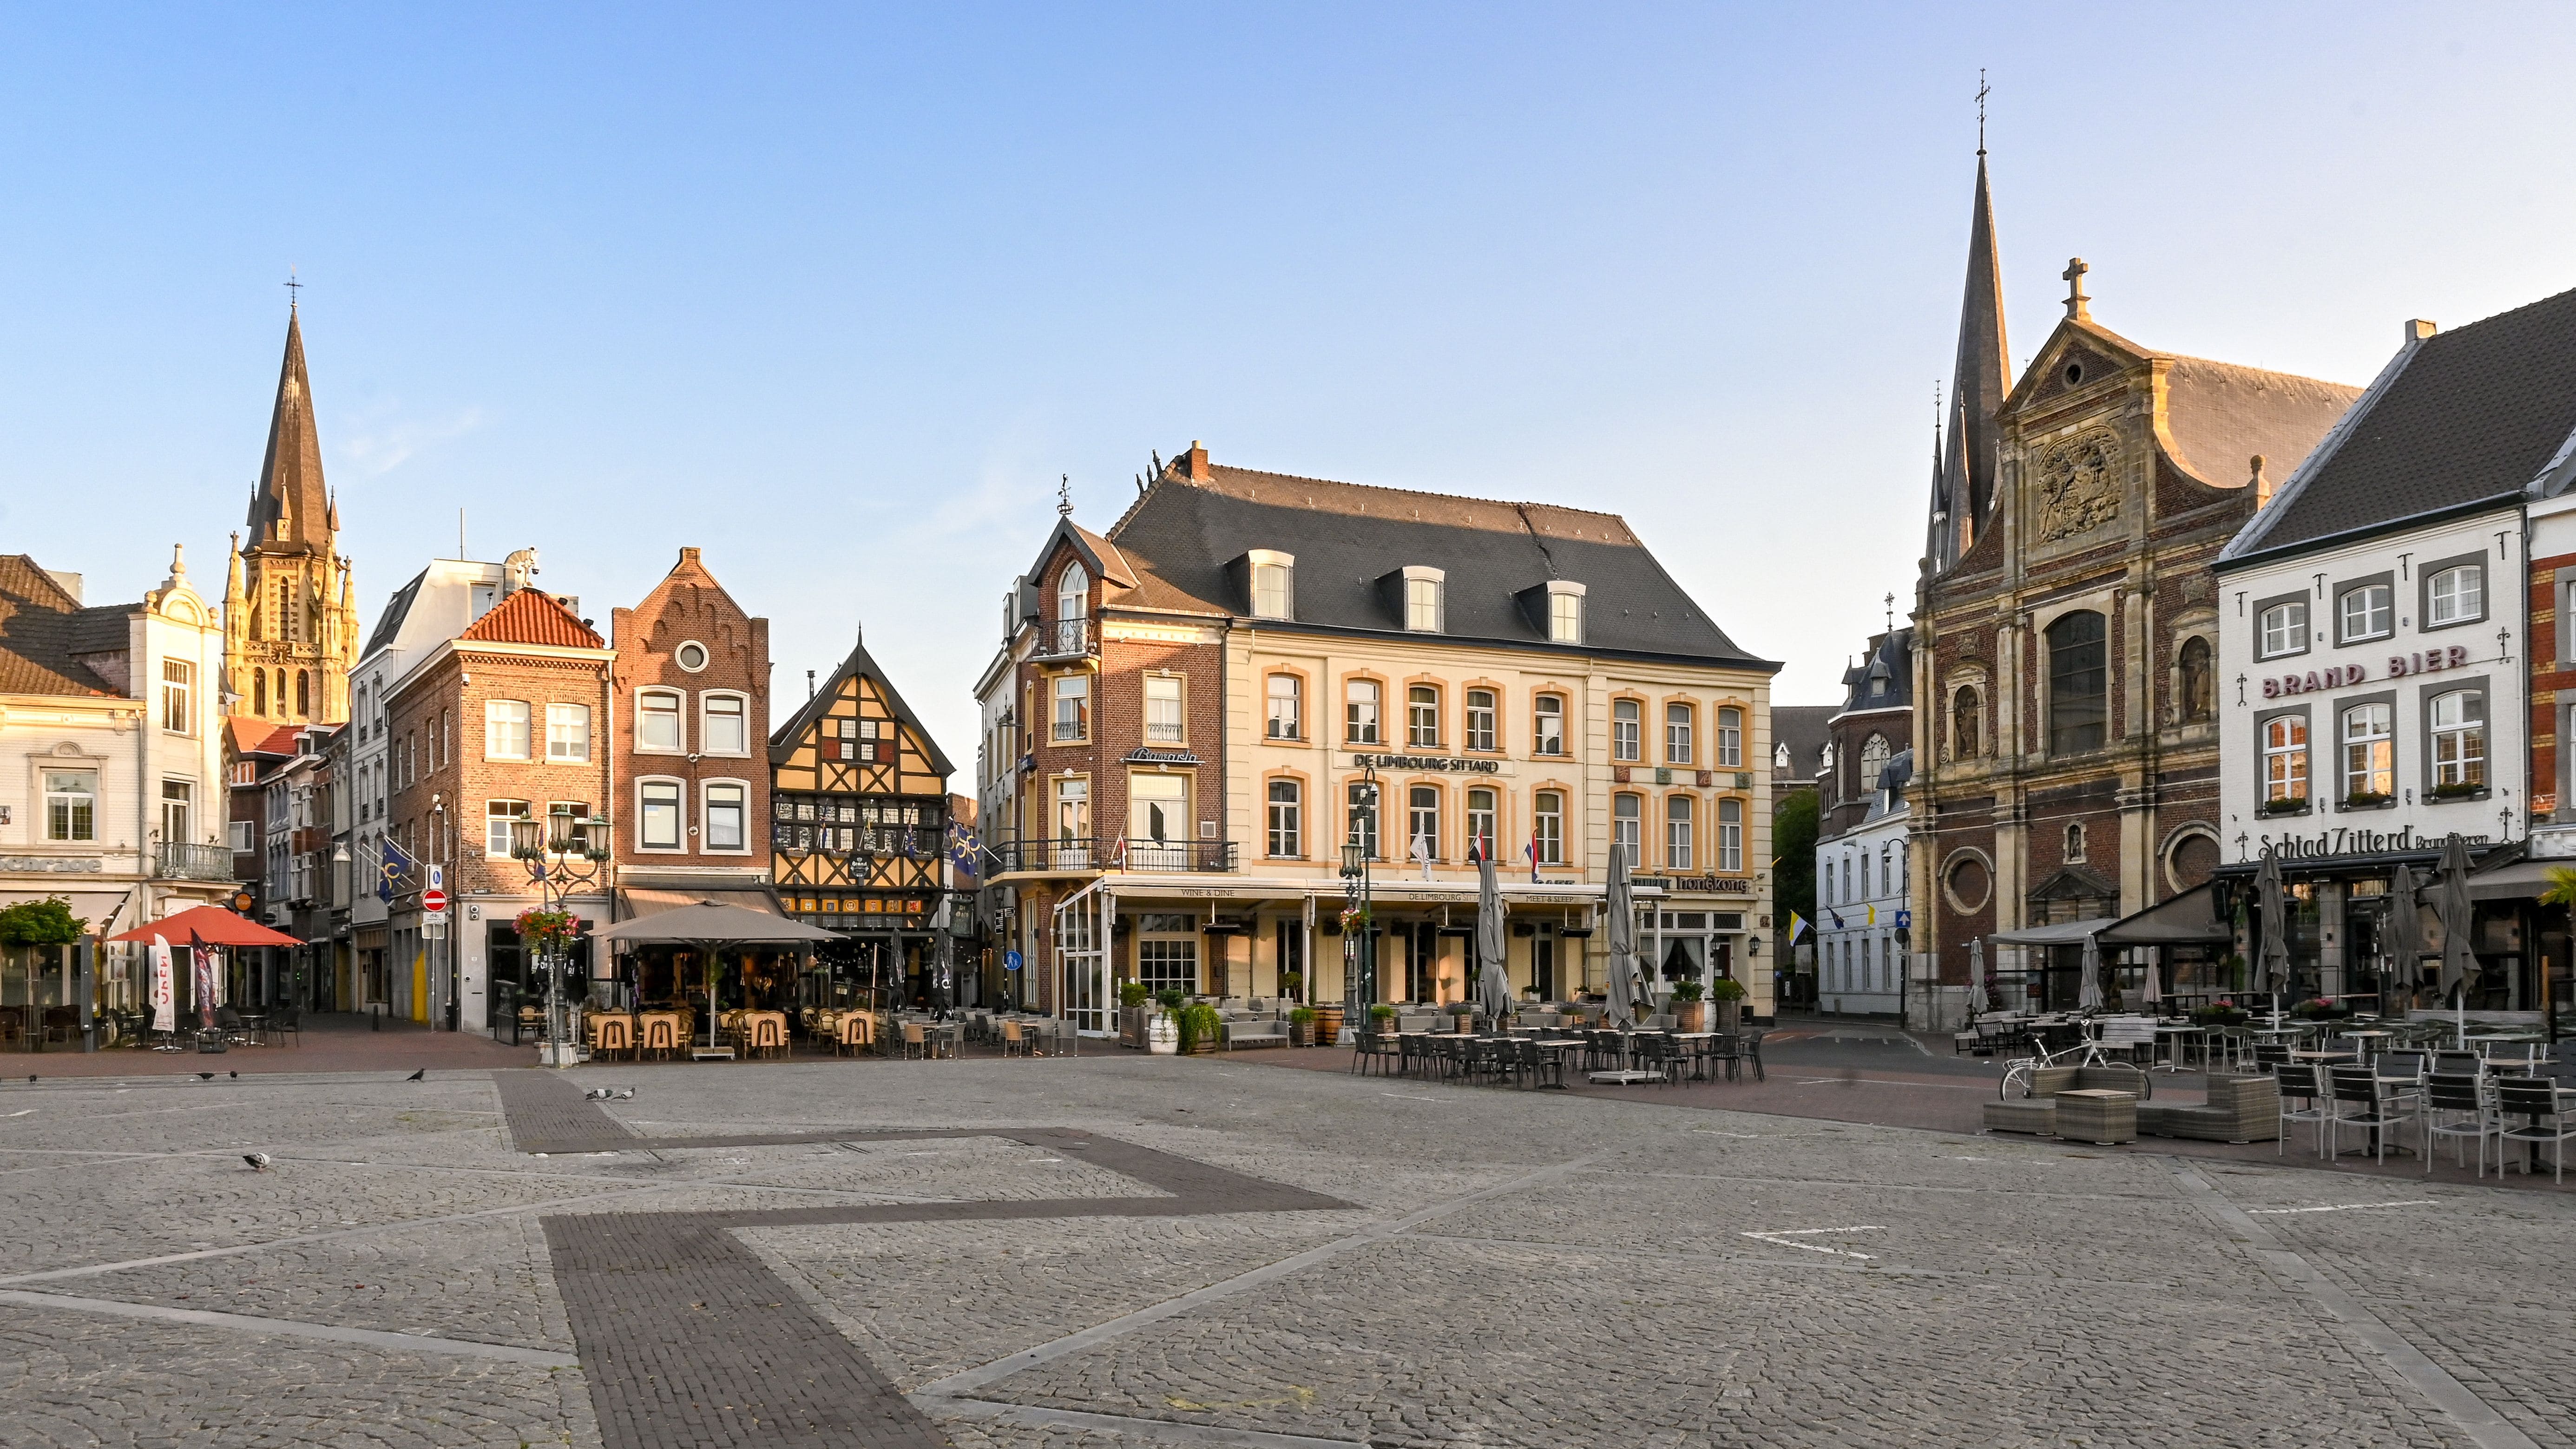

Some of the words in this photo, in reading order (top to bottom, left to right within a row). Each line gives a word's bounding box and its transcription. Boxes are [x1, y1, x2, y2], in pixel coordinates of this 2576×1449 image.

[2262, 663, 2365, 698] BRAND
[2388, 645, 2467, 677] BIER
[1354, 754, 1373, 766] DE
[1377, 755, 1447, 770] LIMBOURG
[1451, 759, 1499, 774] SITTARD
[2331, 825, 2412, 856] Zitterd
